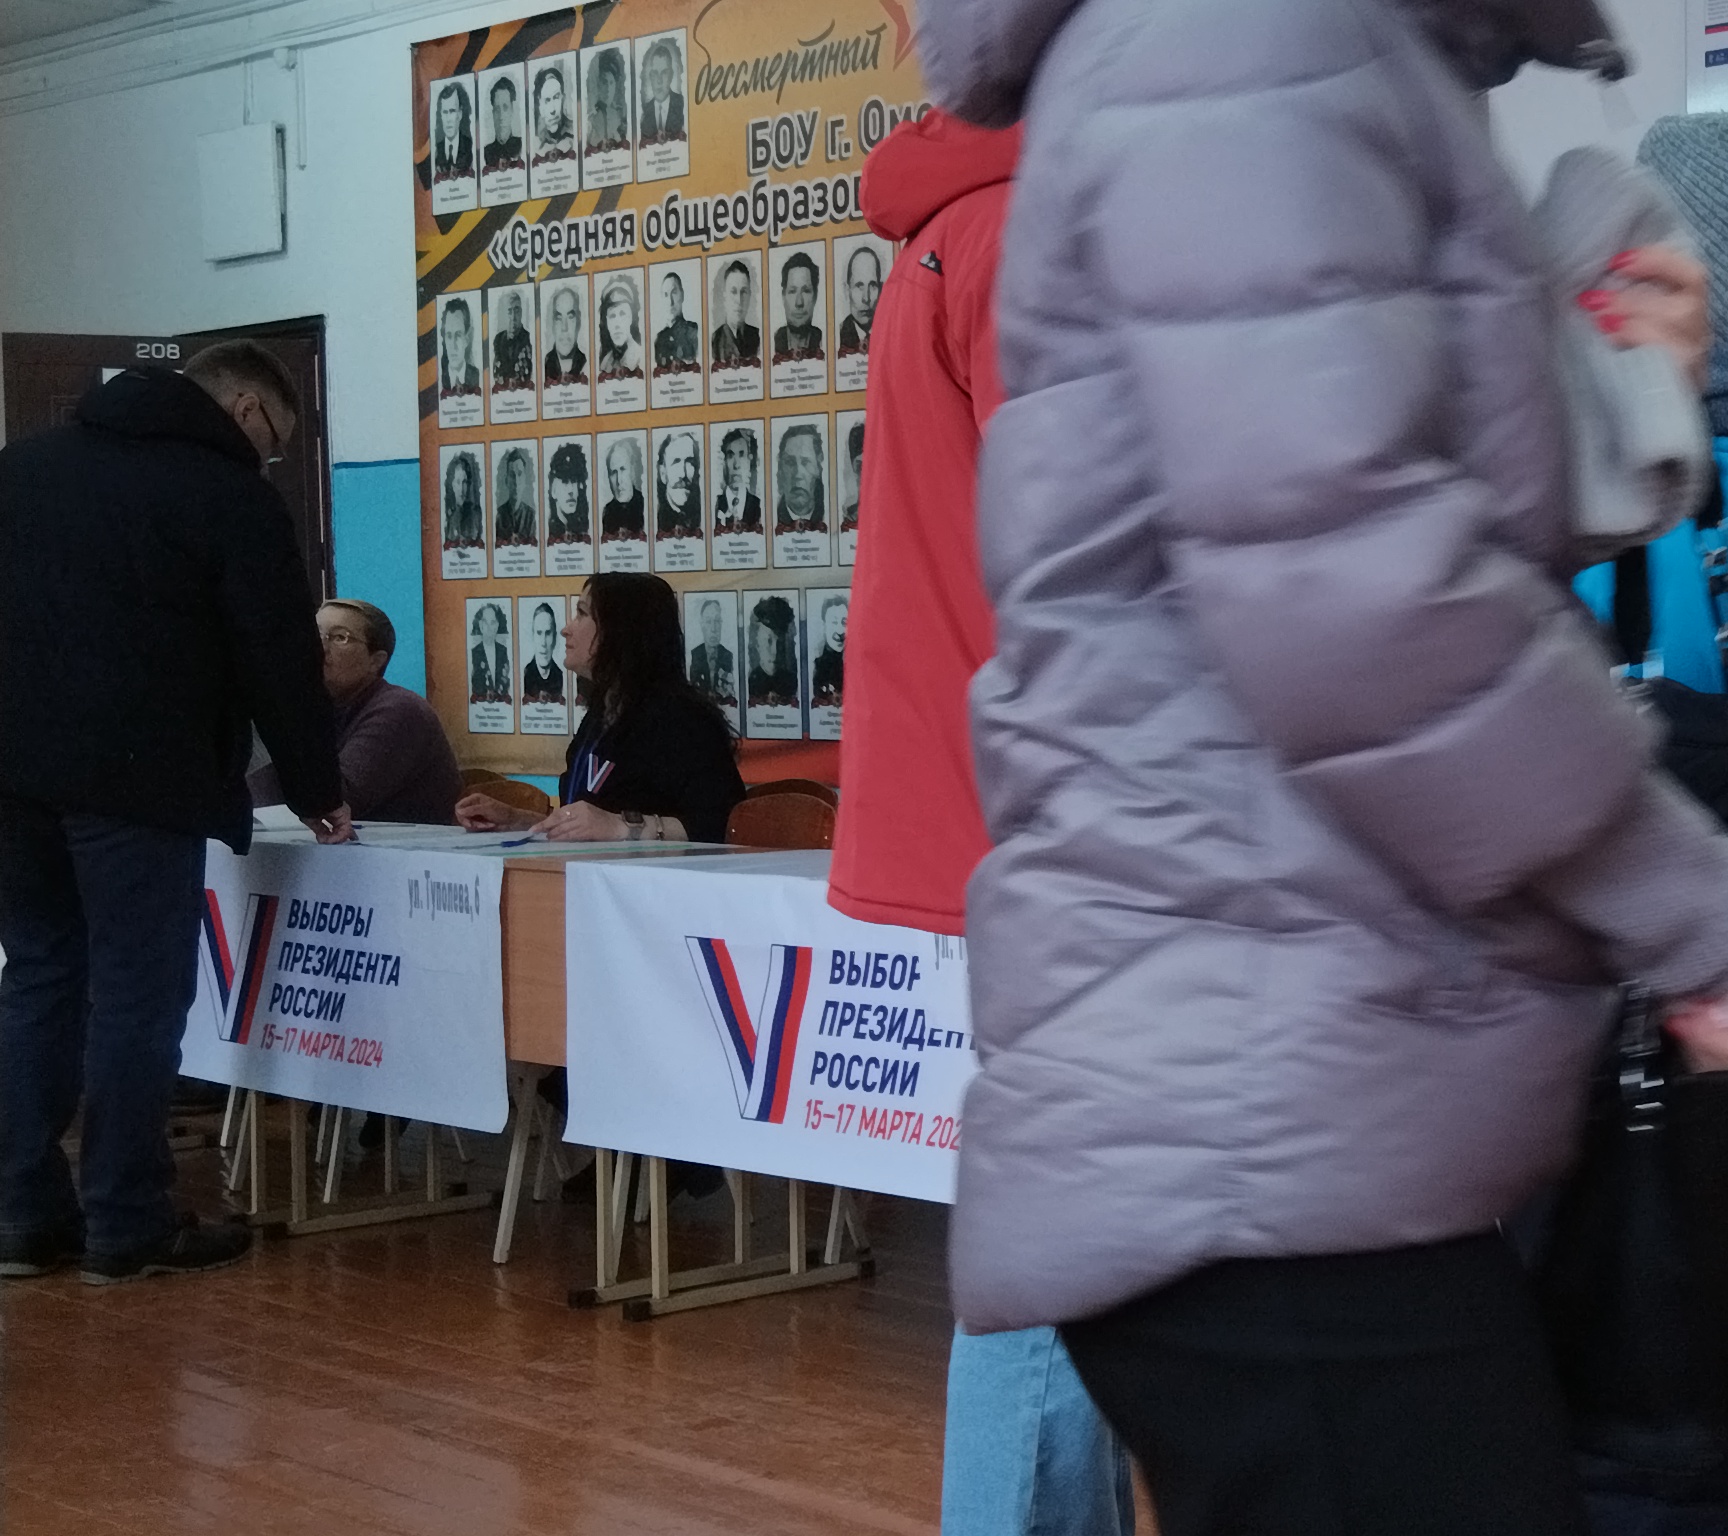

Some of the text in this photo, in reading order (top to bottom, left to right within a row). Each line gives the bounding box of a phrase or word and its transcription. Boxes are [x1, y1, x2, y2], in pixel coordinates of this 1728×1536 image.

[751, 111, 818, 170] БОУ
[831, 119, 850, 155] г.
[491, 213, 635, 272] «Средняя
[136, 343, 181, 360] 208
[287, 899, 373, 937] ВЫБОРЫ
[408, 878, 423, 918] ул.
[278, 941, 400, 986] ПРЕЗИДЕНТА
[829, 950, 921, 991] ВЫБОР
[269, 983, 346, 1023] РОССИИ
[299, 1029, 345, 1064] МАРТА
[347, 1038, 383, 1068] 2024
[810, 1051, 920, 1097] РОССИИ
[857, 1106, 923, 1145] МАРТА
[926, 1115, 961, 1150] 202
